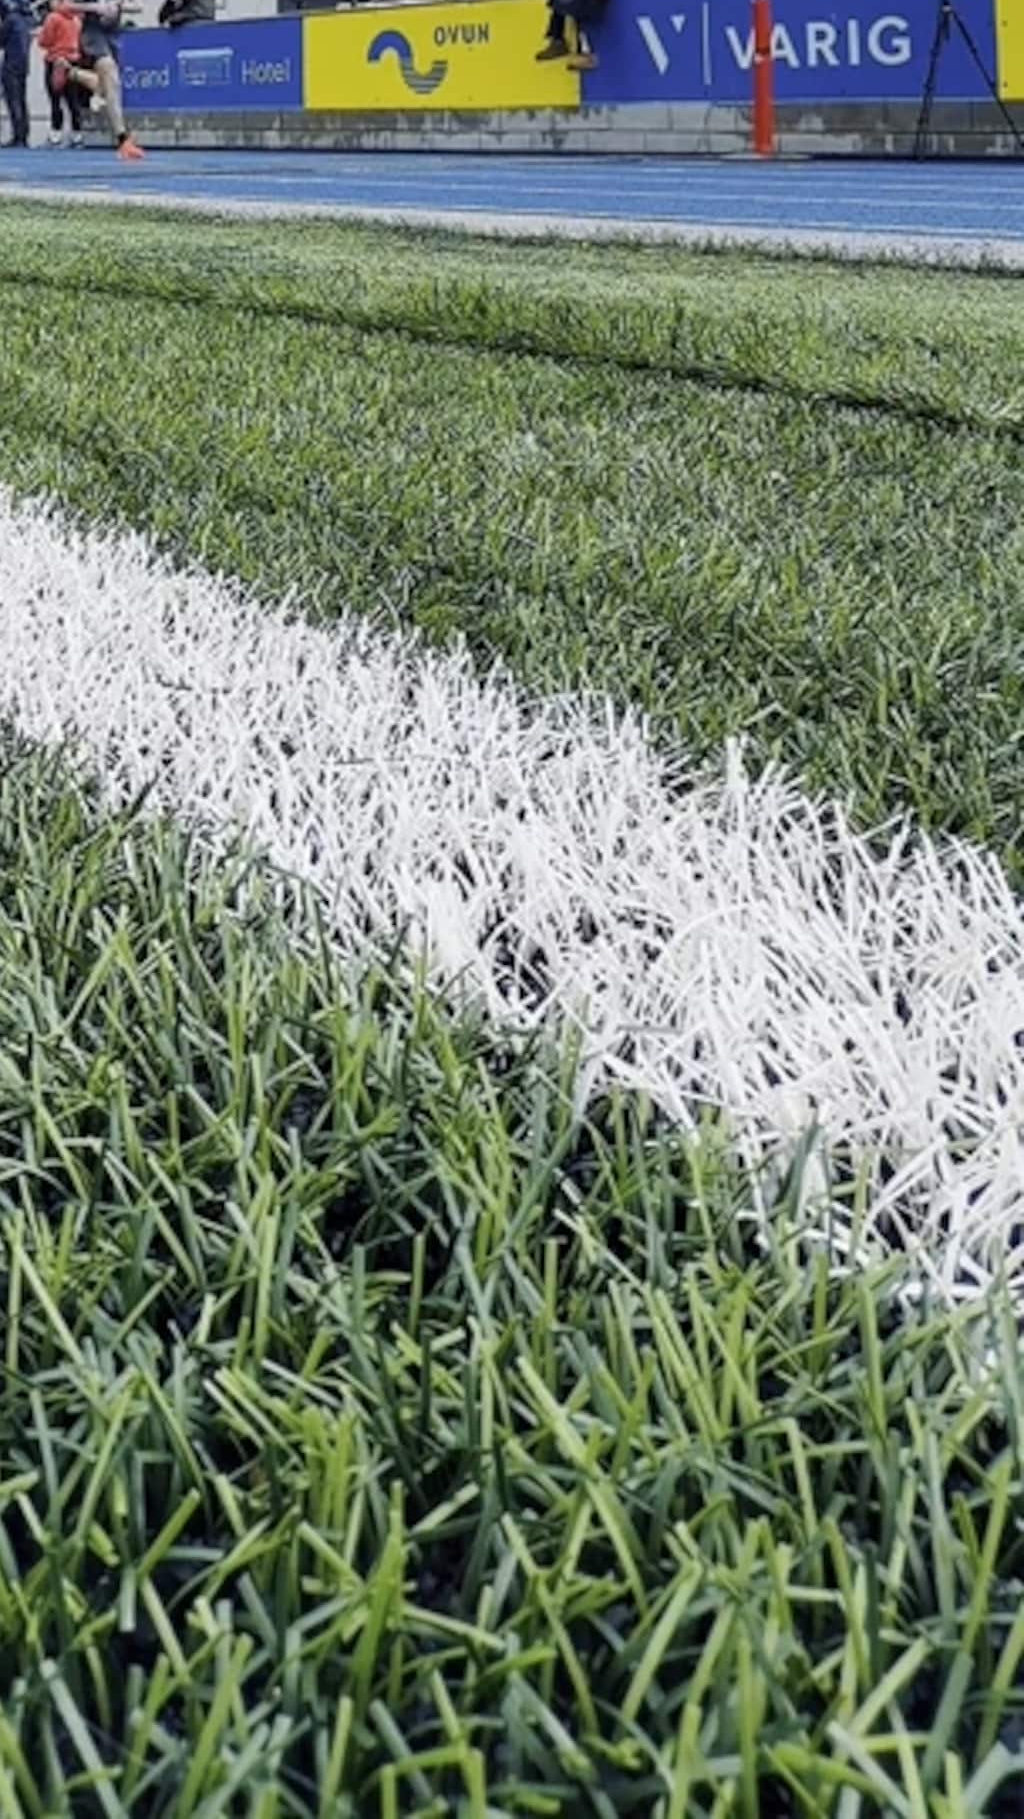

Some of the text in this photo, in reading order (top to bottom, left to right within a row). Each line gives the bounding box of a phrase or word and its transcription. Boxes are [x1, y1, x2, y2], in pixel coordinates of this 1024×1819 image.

[433, 21, 490, 47] OVUN
[726, 15, 912, 70] VARIG
[240, 57, 292, 86] Hotel
